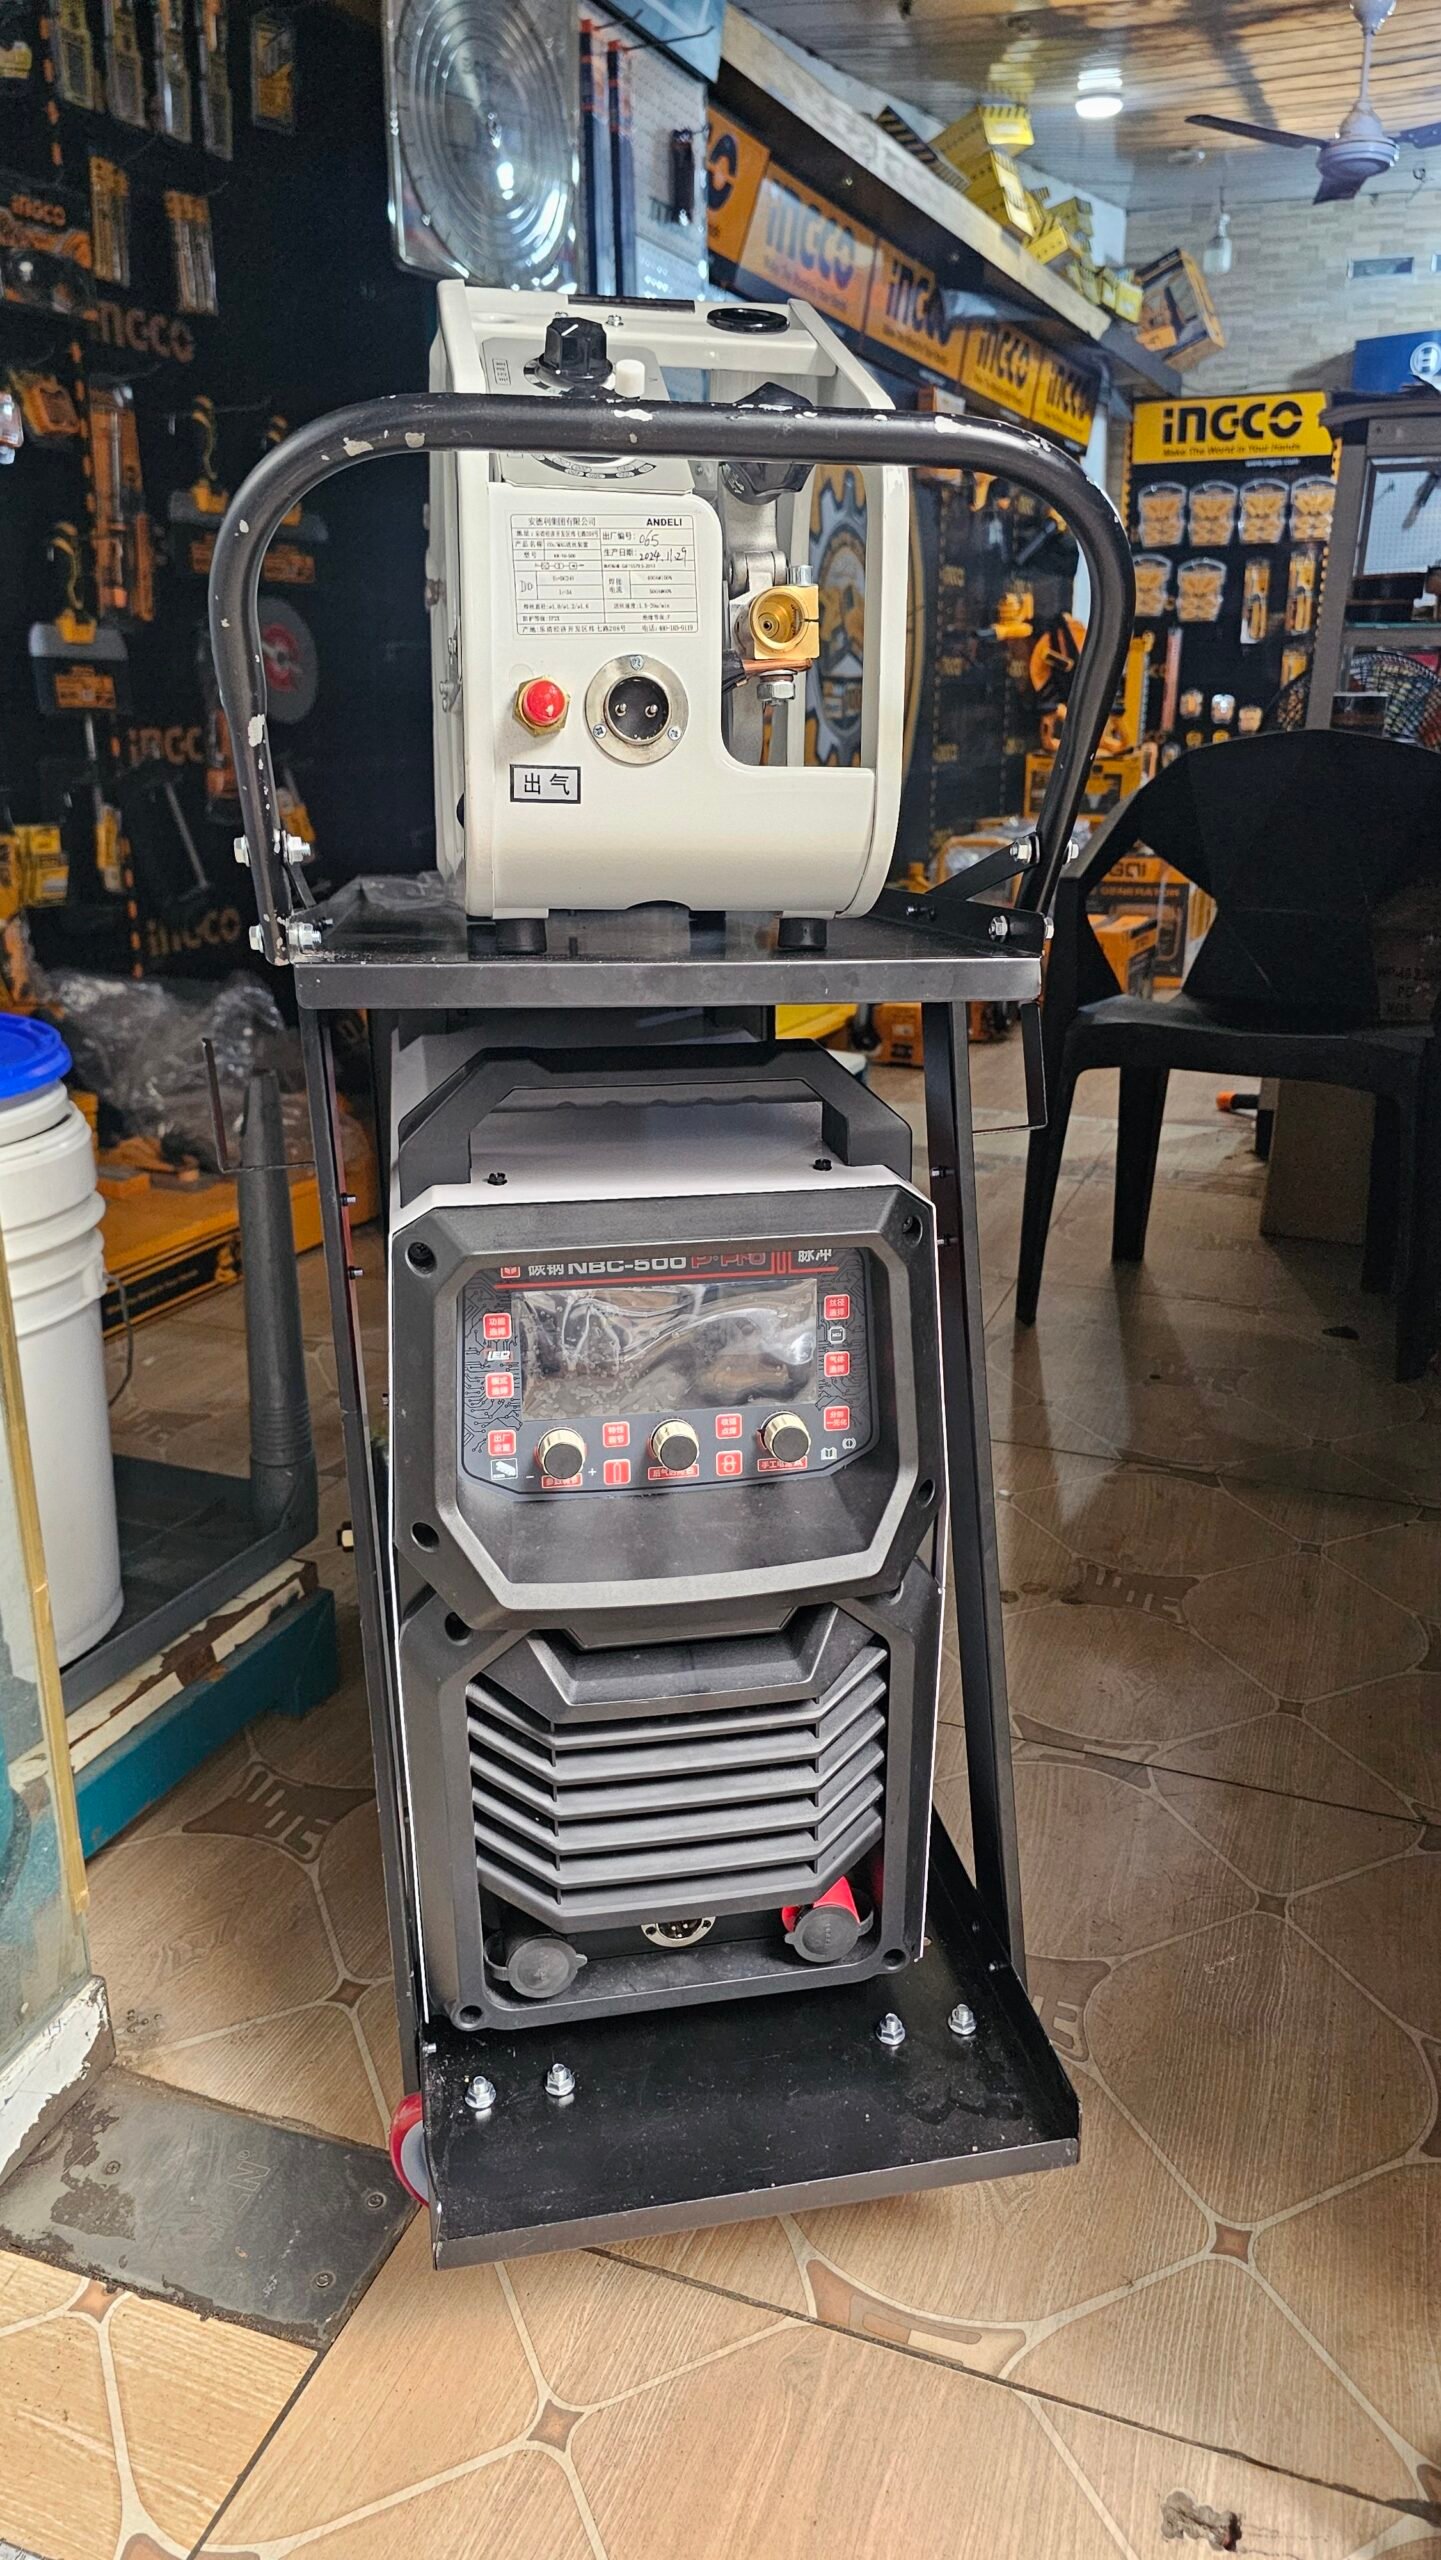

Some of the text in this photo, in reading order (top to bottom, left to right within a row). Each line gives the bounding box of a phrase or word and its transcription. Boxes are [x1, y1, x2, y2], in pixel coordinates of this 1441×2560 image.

[1163, 401, 1303, 444] INGCO
[646, 518, 682, 527] ANDELI
[639, 529, 660, 547] 065
[523, 772, 571, 796] 出气
[568, 1256, 687, 1275] NBC-500
[798, 1249, 832, 1263] 脉冲
[489, 1317, 506, 1326] 功能
[493, 1434, 511, 1442] 出厂
